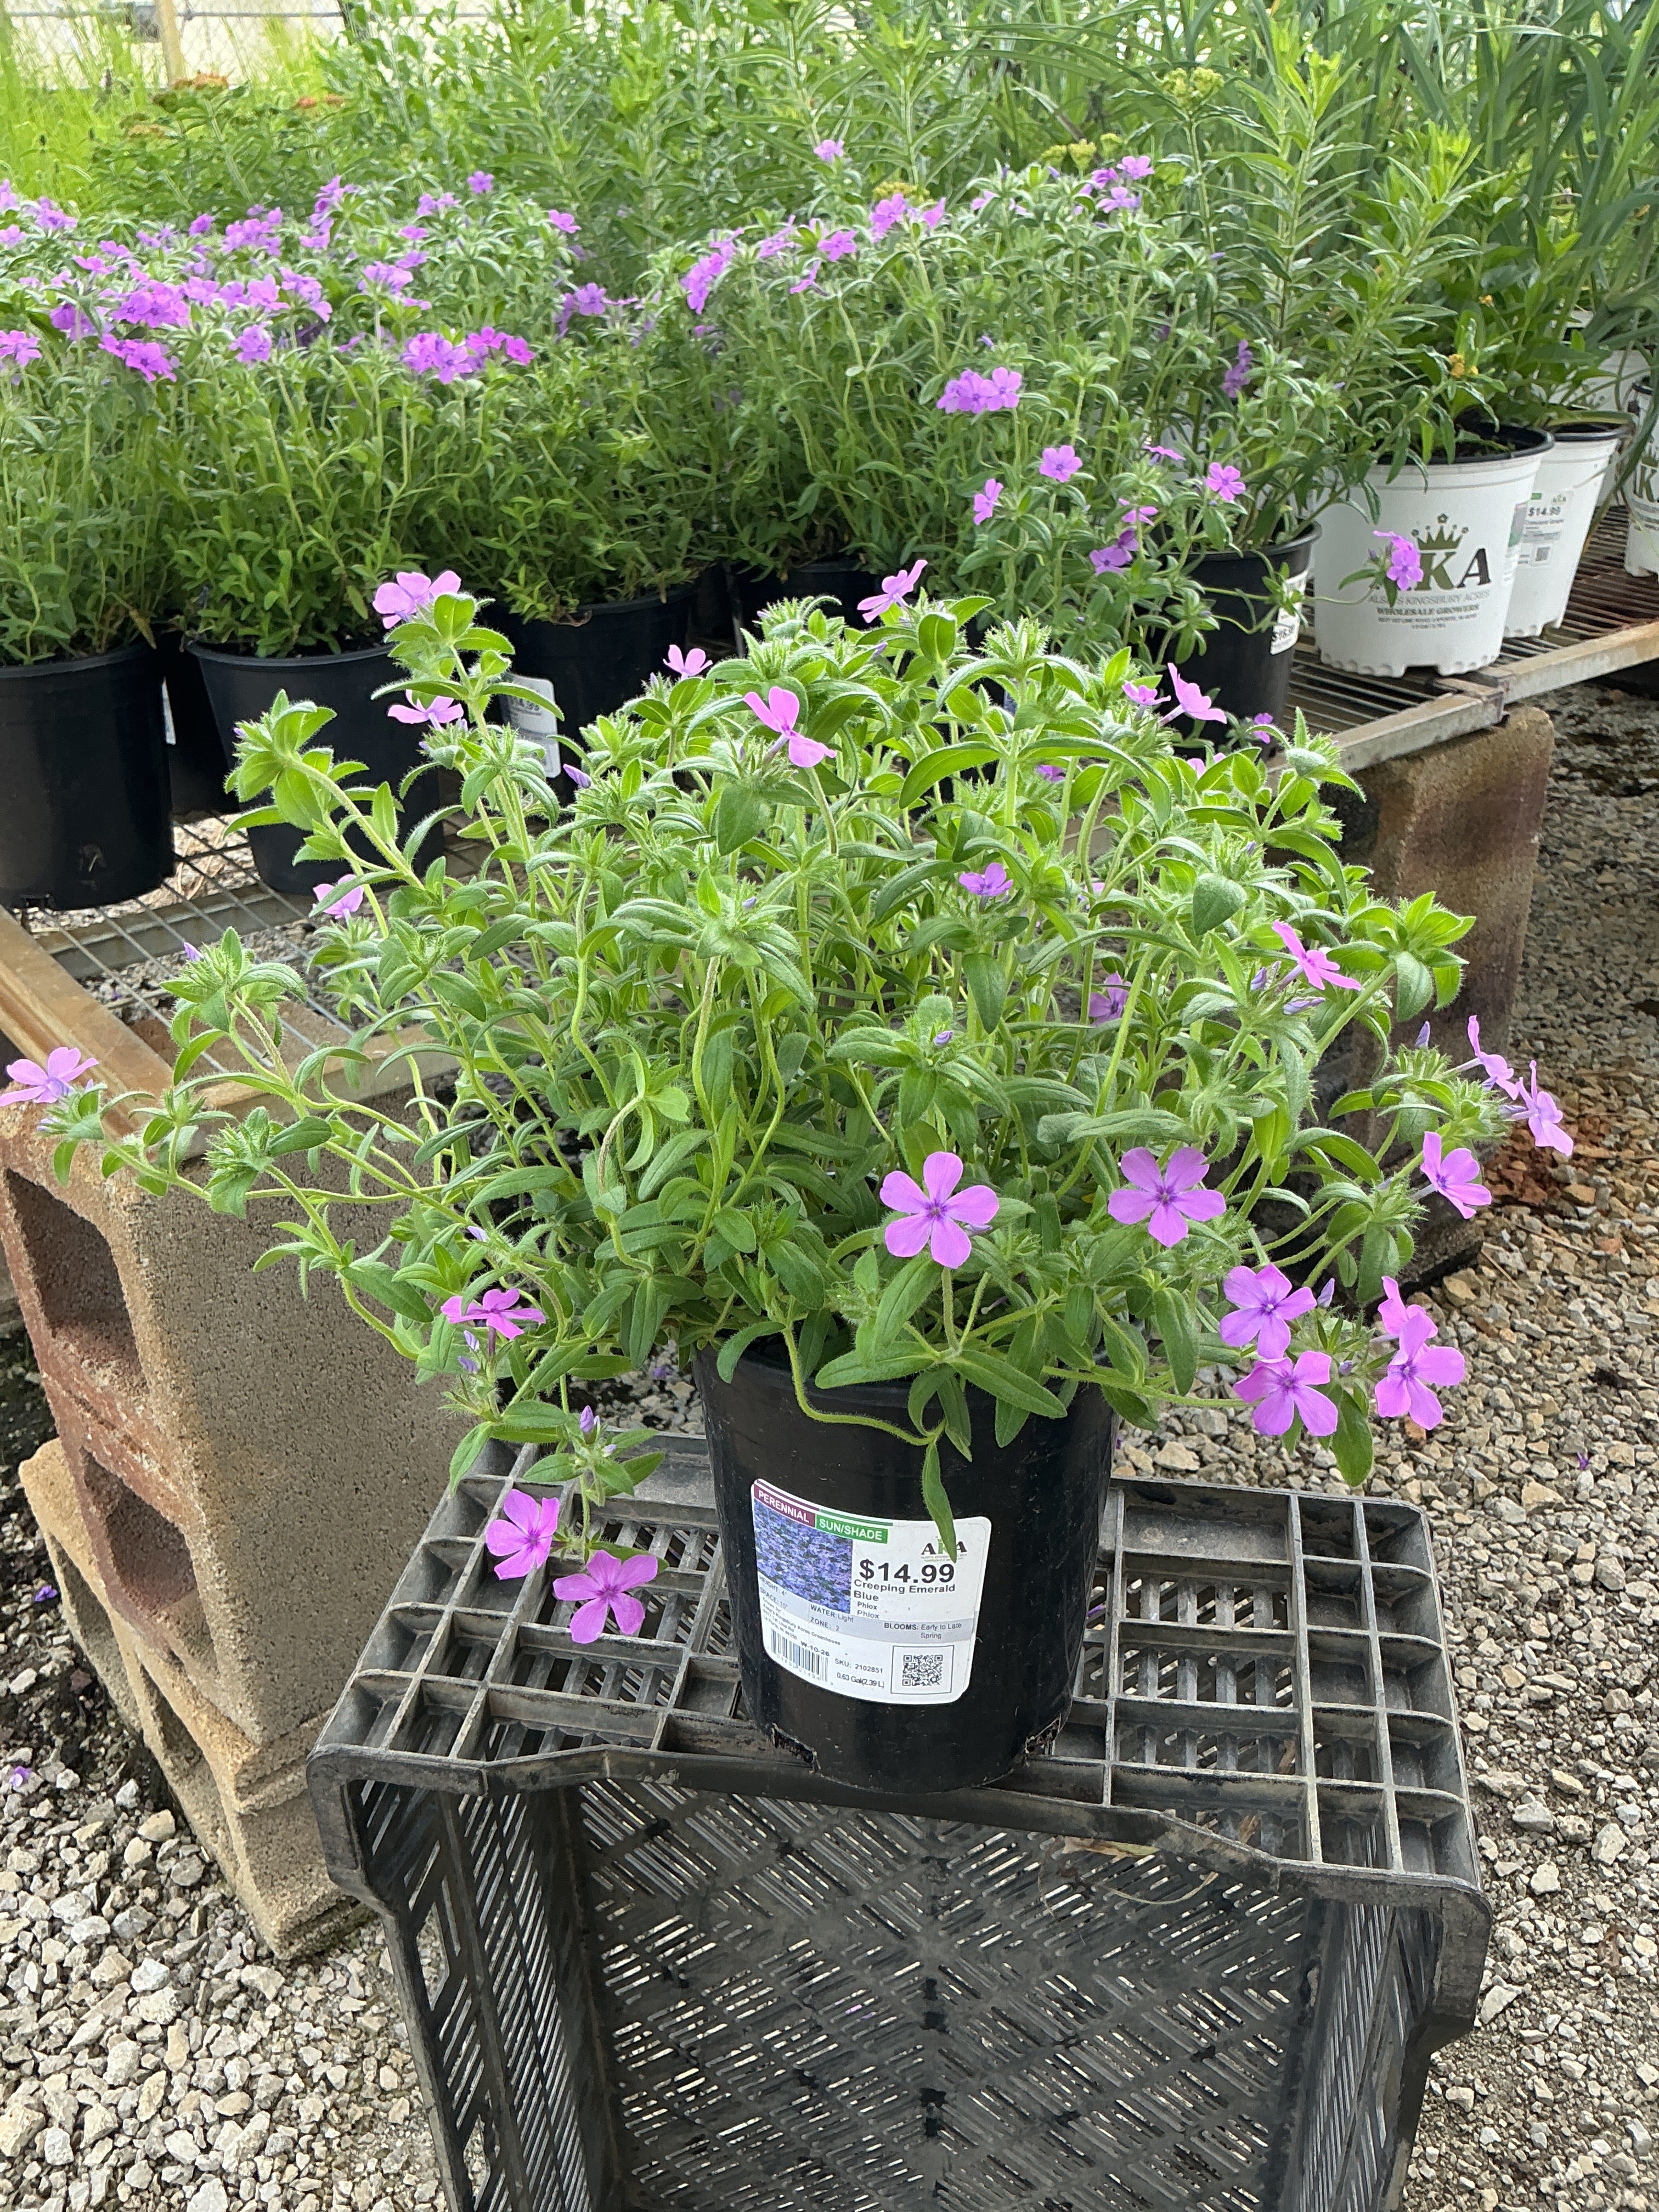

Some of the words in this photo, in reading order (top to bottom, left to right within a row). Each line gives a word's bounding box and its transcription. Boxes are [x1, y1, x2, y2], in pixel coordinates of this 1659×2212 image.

[758, 1489, 810, 1523] PERENNIAL
[819, 1518, 883, 1541] SUN/SHADE
[859, 1559, 955, 1584] $14.99
[854, 1579, 905, 1594] Creeping
[909, 1583, 956, 1594] Emerald
[854, 1590, 879, 1601] Blue
[857, 1601, 878, 1610] Phlox
[857, 1610, 879, 1618] Phlox
[810, 1616, 831, 1629] ZONE:
[884, 1622, 919, 1630] BLOOMS:
[811, 1631, 840, 1645] Greenhouse
[834, 1658, 851, 1668] SKU:
[854, 1663, 883, 1673] 2102851
[837, 1672, 849, 1680] 0.63
